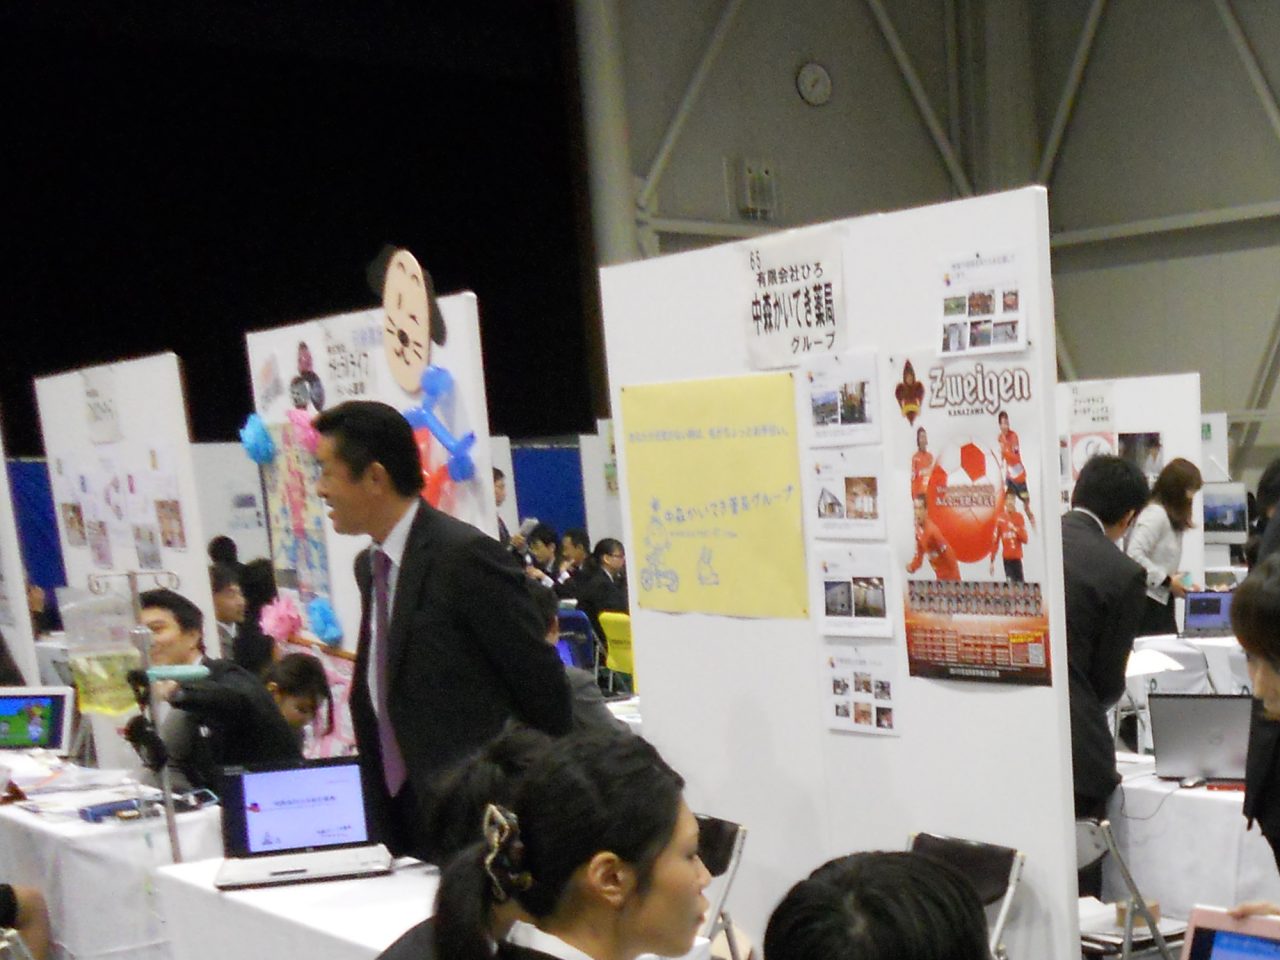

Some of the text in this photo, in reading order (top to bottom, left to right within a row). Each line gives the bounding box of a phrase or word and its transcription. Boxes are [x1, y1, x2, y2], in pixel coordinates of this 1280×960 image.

[756, 262, 824, 288] 有限会社ひろ
[791, 331, 836, 354] グループ
[929, 363, 1032, 415] Zweigen
[948, 407, 985, 417] KANAZAWA
